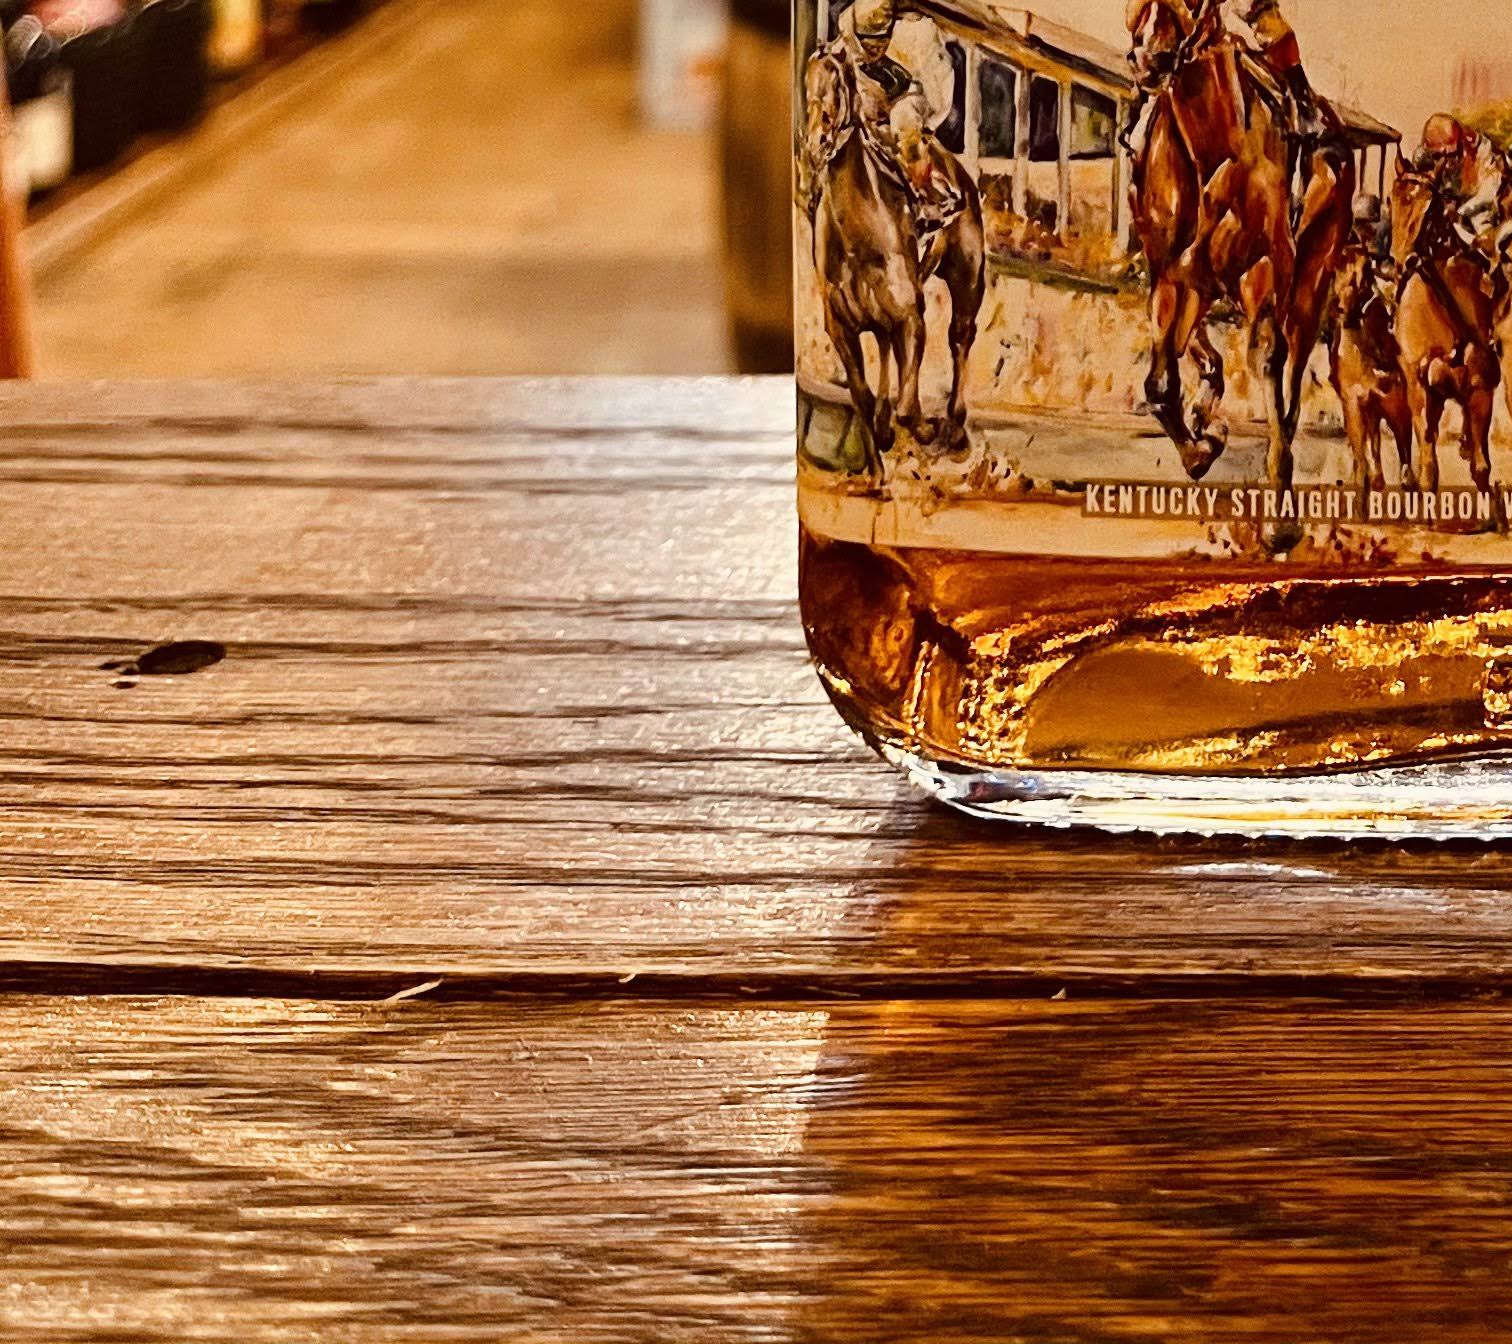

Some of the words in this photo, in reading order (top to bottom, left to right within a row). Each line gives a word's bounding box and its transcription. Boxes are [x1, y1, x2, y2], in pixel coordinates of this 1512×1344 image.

[1084, 484, 1220, 517] KENTUCKY
[1230, 488, 1357, 519] STRAIGHT
[1368, 490, 1492, 521] BOURBON
